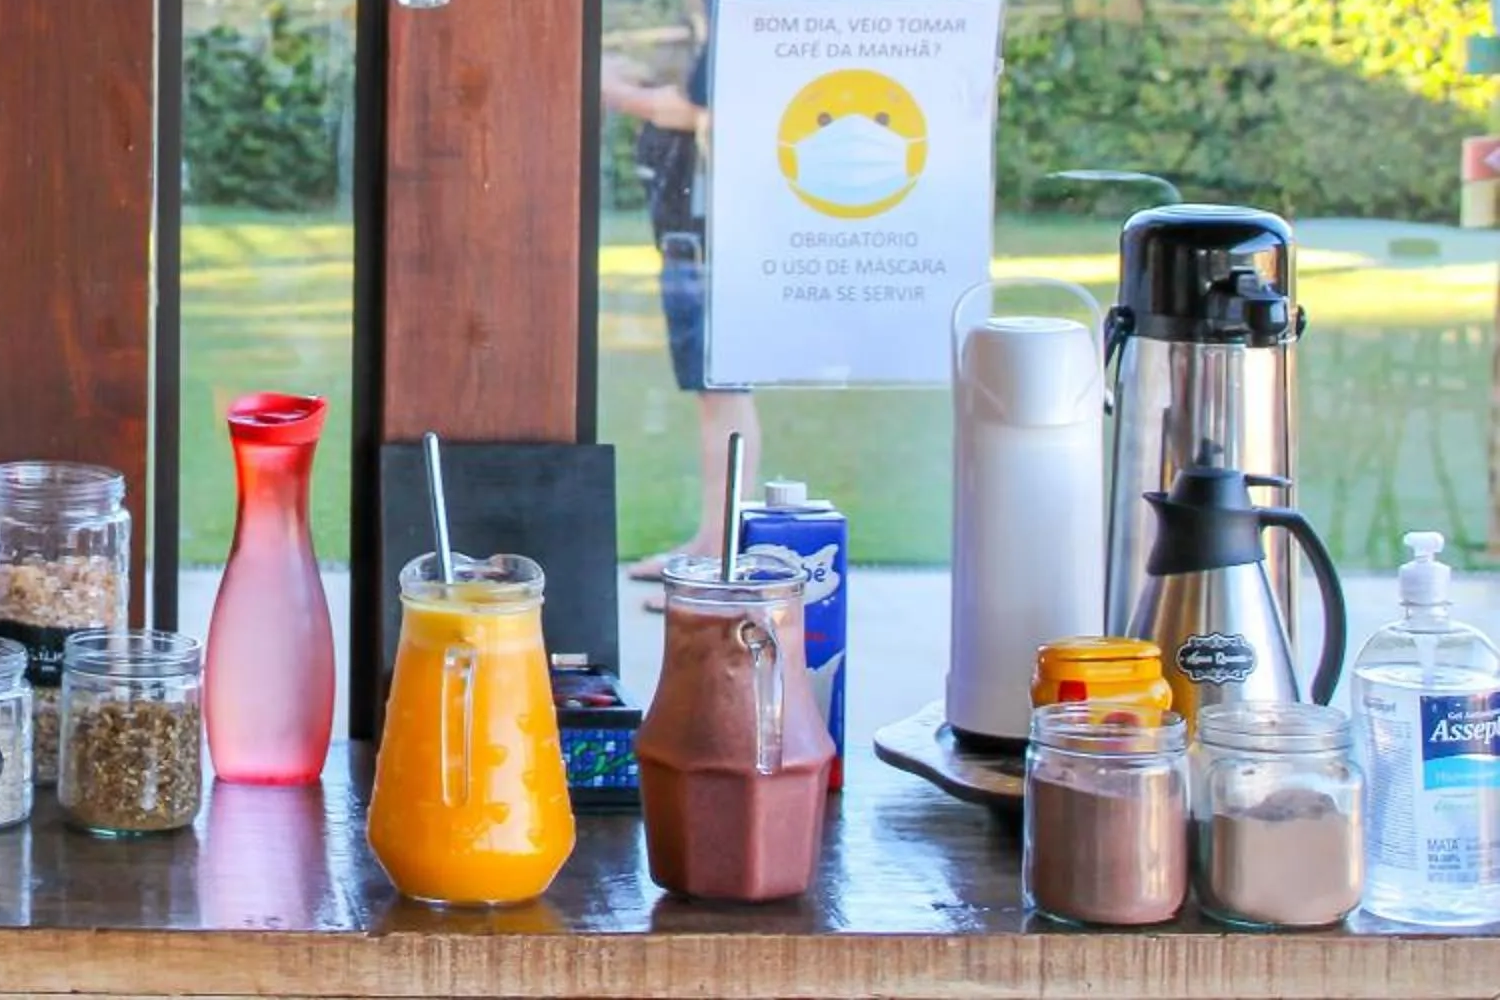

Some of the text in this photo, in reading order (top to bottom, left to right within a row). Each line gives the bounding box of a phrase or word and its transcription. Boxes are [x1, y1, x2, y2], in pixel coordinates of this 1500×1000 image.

[753, 16, 967, 35] BOM DIA, VEIO TOMAR
[774, 39, 821, 58] CAFÉ
[826, 42, 852, 58] DA
[761, 258, 777, 276] O
[782, 258, 821, 276] USO
[826, 258, 850, 276] DE
[782, 285, 925, 302] PARA SE SERVIR
